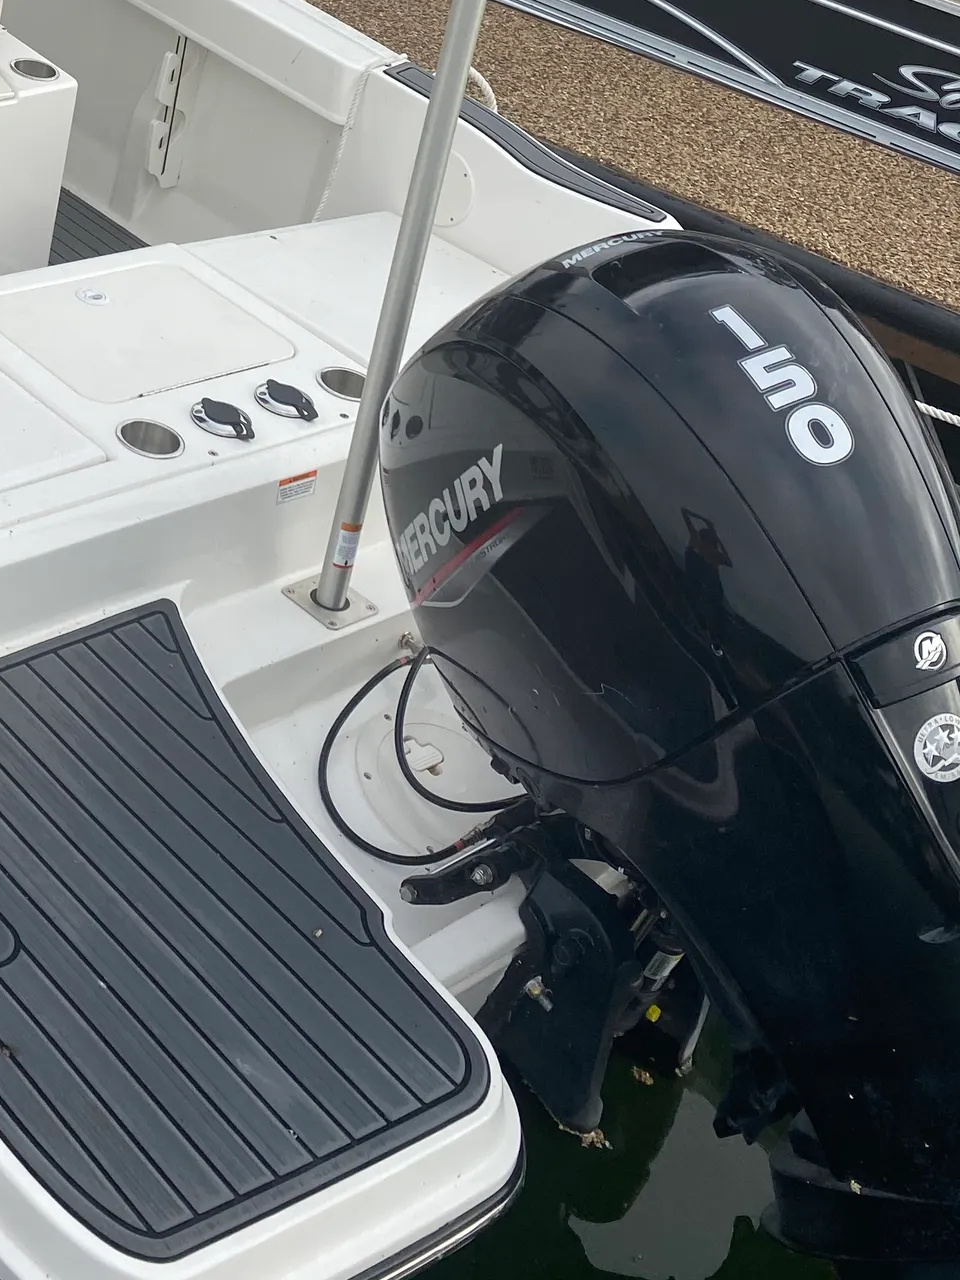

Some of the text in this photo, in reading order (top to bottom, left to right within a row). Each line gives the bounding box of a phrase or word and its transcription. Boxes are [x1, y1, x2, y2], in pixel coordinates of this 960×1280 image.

[562, 230, 665, 269] MERCURY
[709, 304, 855, 466] 150
[398, 443, 504, 580] MERCURY
